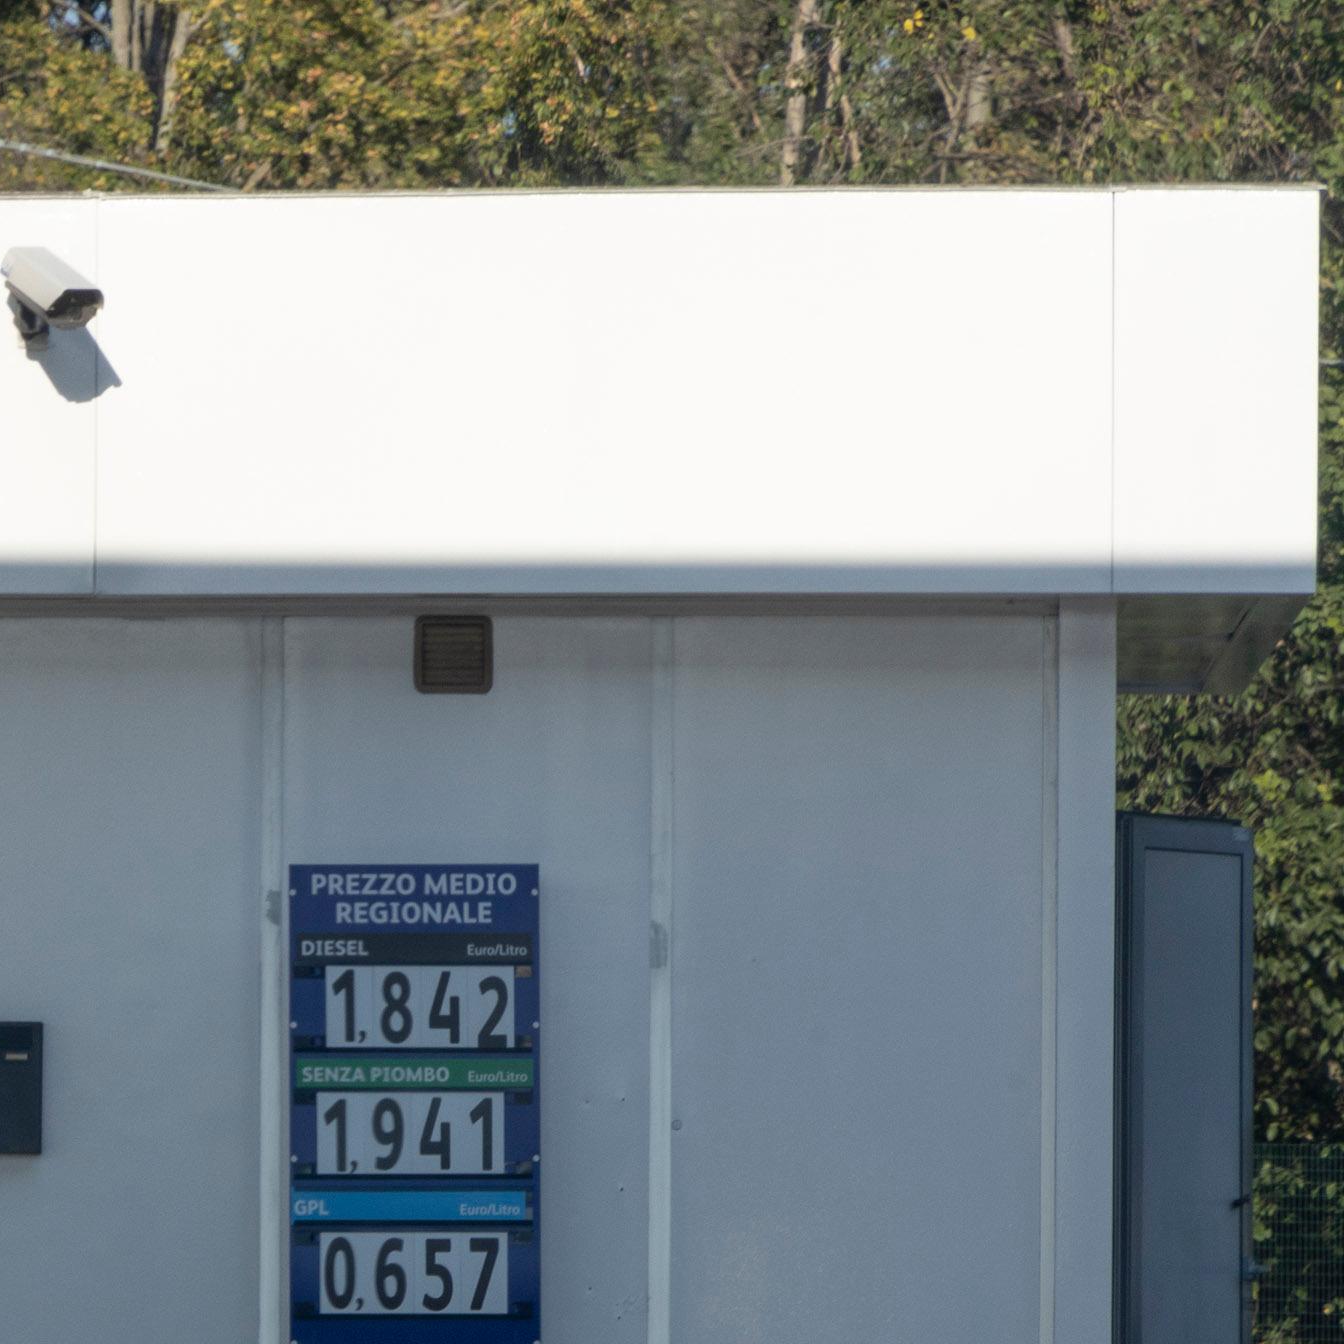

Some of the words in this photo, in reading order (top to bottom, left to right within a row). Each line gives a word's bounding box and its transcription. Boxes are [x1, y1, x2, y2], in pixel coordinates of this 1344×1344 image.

[310, 873, 416, 896] PREZZO
[423, 872, 518, 896] MEDIO
[335, 901, 493, 925] REGIONALE
[301, 940, 369, 958] DIESEL
[466, 943, 528, 958] Euro/Litro
[331, 969, 509, 1047] 1,842
[301, 1066, 365, 1083] SENZA
[369, 1065, 450, 1083] PIOMBO
[467, 1069, 528, 1084] Euro/Litro
[323, 1096, 493, 1173] 1,941
[294, 1199, 330, 1217] GPL
[459, 1202, 521, 1217] Euro/Litro
[323, 1236, 501, 1312] 0,657
